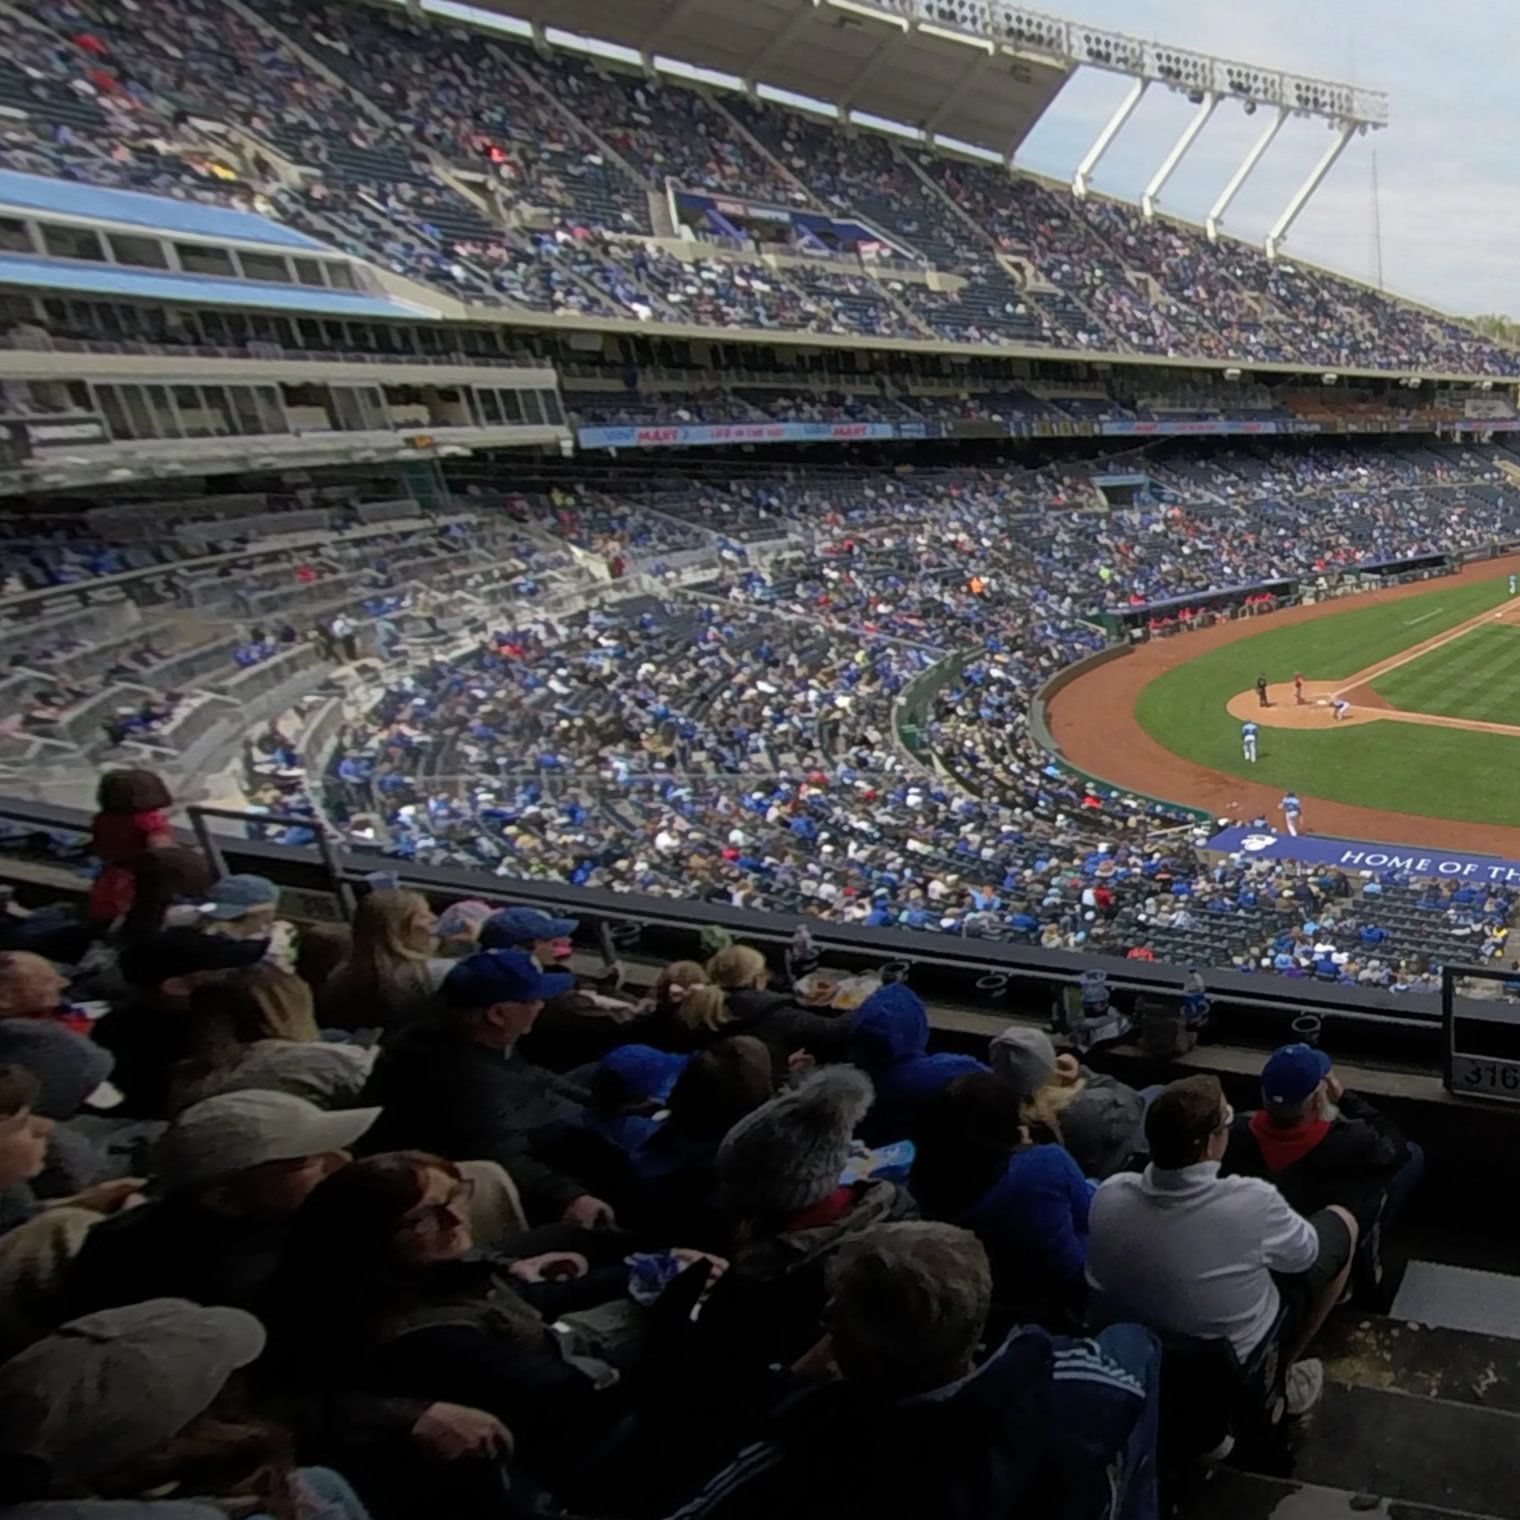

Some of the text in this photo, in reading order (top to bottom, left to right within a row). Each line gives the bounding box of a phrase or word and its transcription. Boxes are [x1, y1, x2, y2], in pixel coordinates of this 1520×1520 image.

[1339, 850, 1432, 871] HOME
[1438, 861, 1480, 877] OF
[1464, 1060, 1520, 1090] 316
